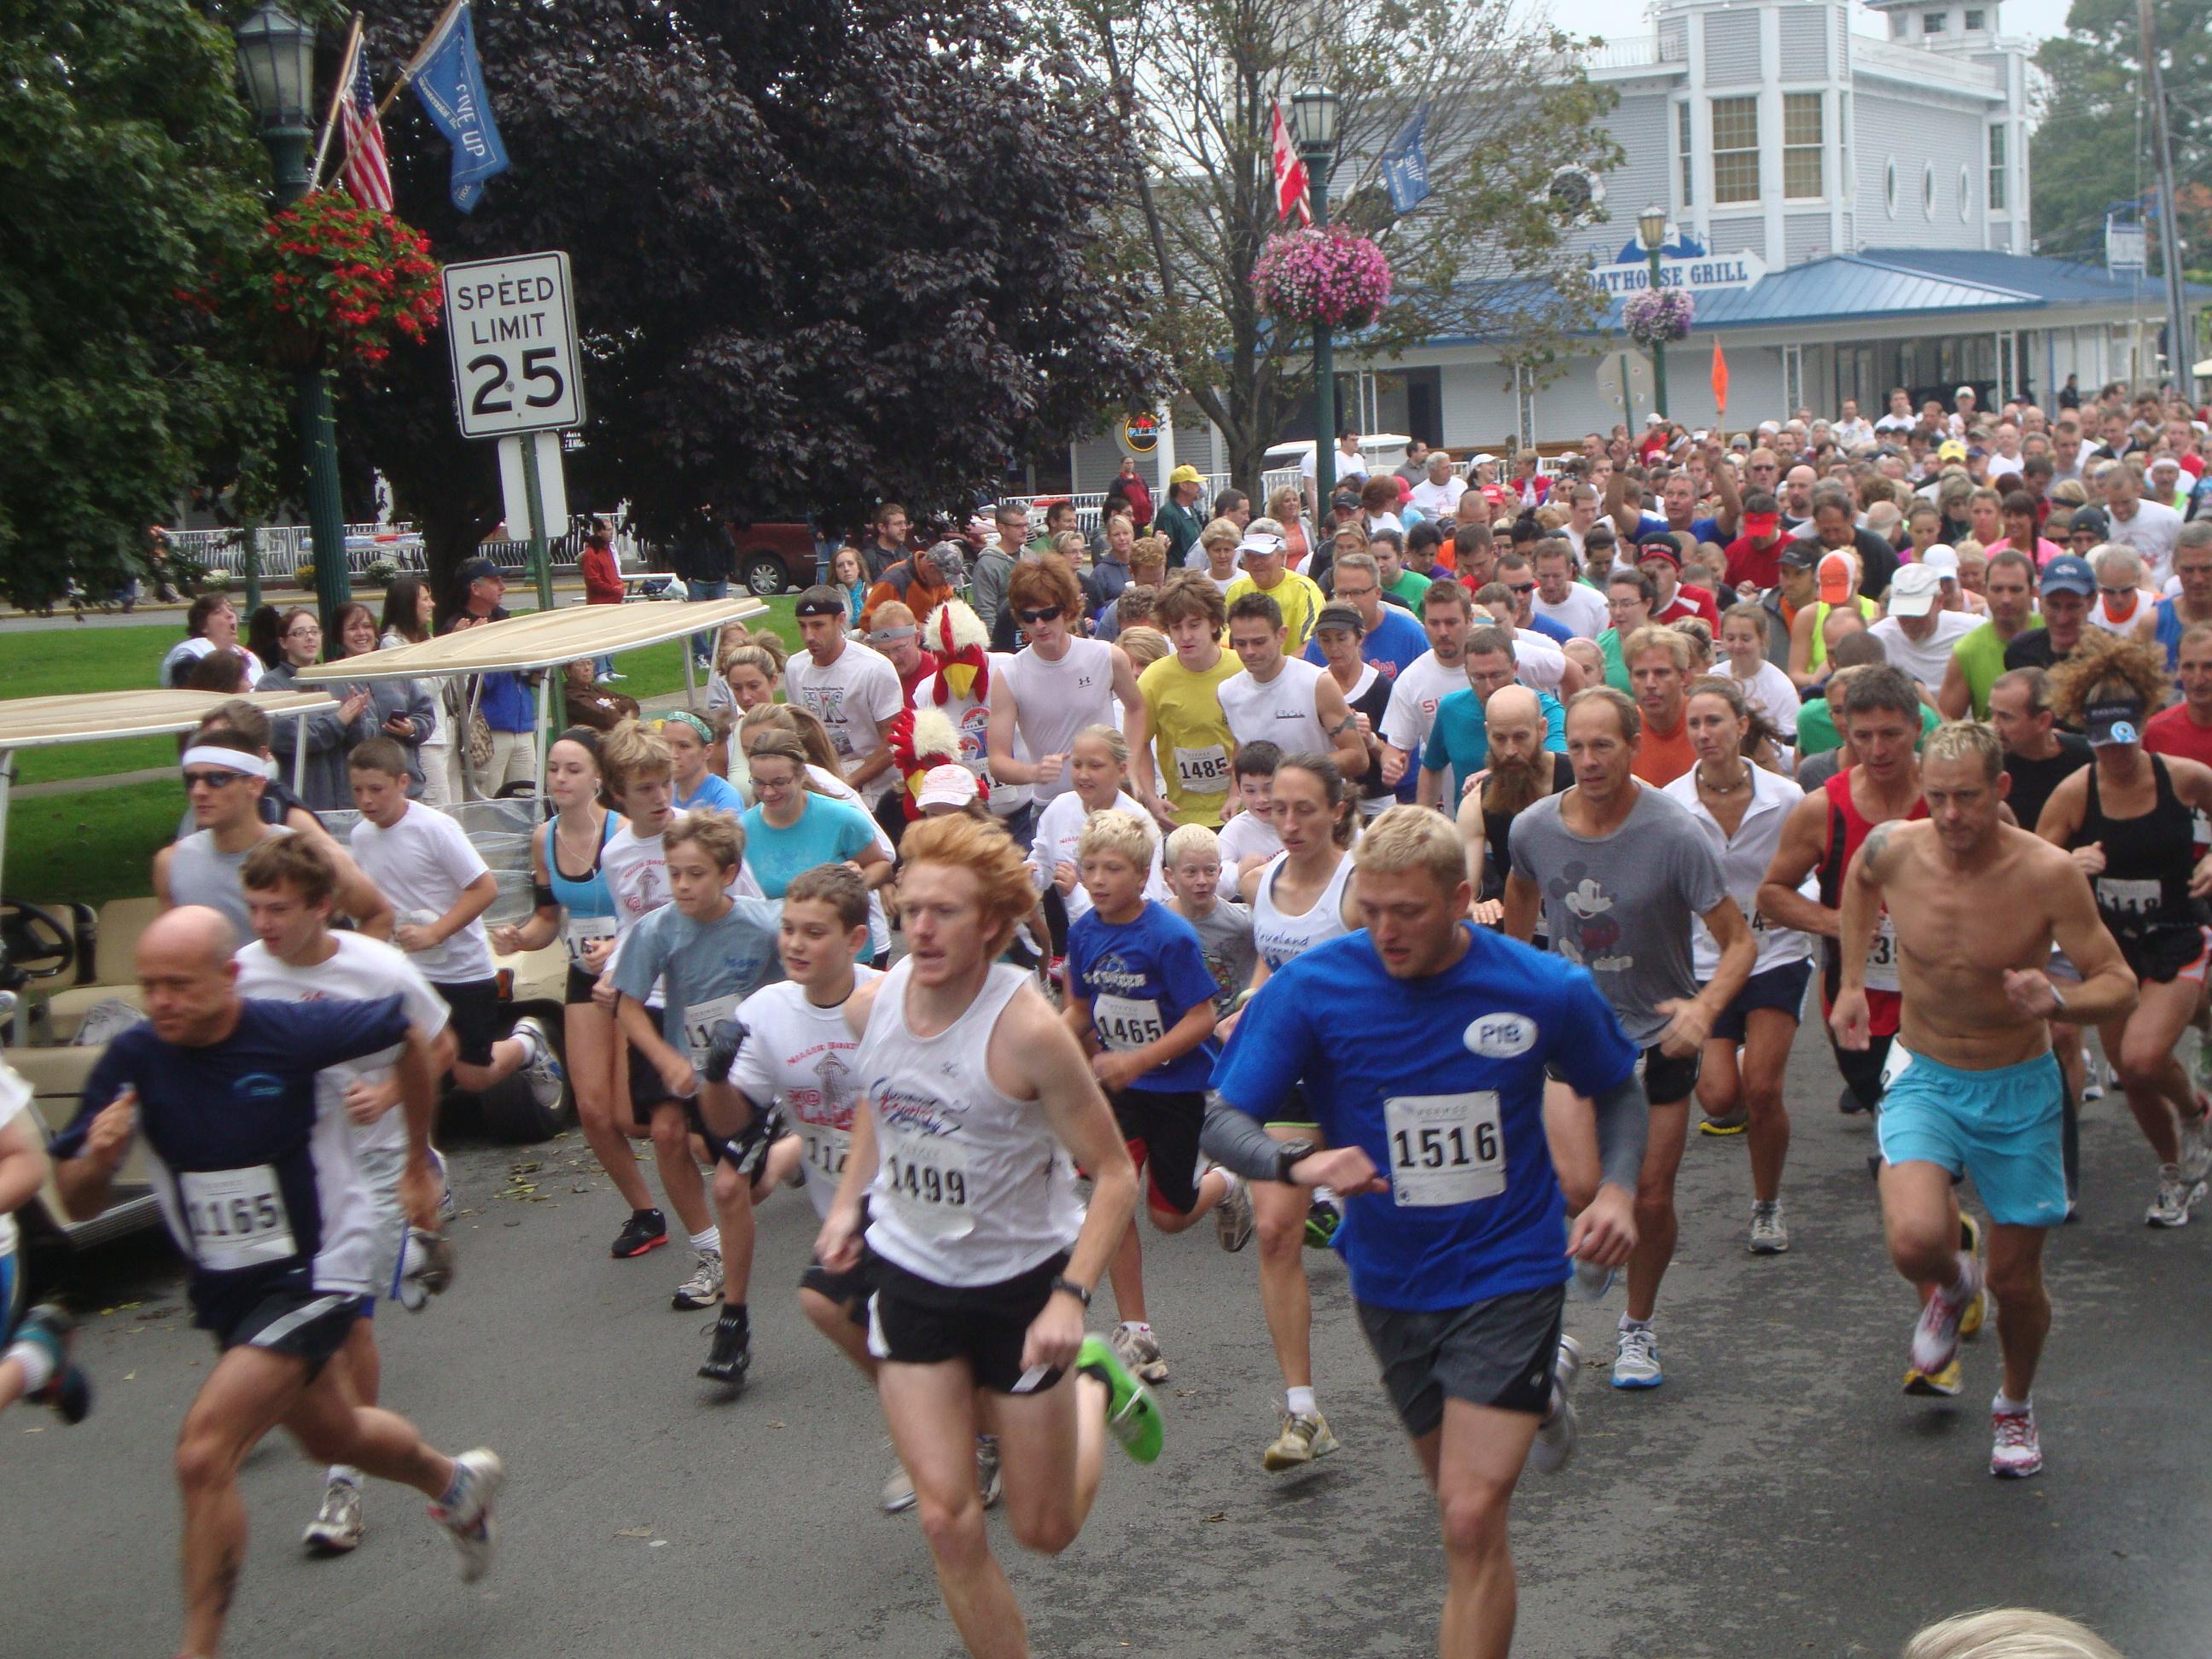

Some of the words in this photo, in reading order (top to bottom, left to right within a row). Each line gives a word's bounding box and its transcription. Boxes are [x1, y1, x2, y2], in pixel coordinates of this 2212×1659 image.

[461, 129, 486, 157] UP
[1582, 265, 1684, 292] OATHOSE
[1690, 260, 1749, 285] GRILL
[457, 276, 555, 311] SPEED
[471, 311, 546, 345] LIMIT
[466, 346, 564, 416] 25
[1179, 756, 1228, 779] 1485
[1255, 926, 1310, 946] leveland
[1097, 1016, 1161, 1045] 1465
[1394, 1122, 1497, 1169] 1516
[888, 1155, 965, 1206] 1499
[189, 1193, 277, 1237] 1165
